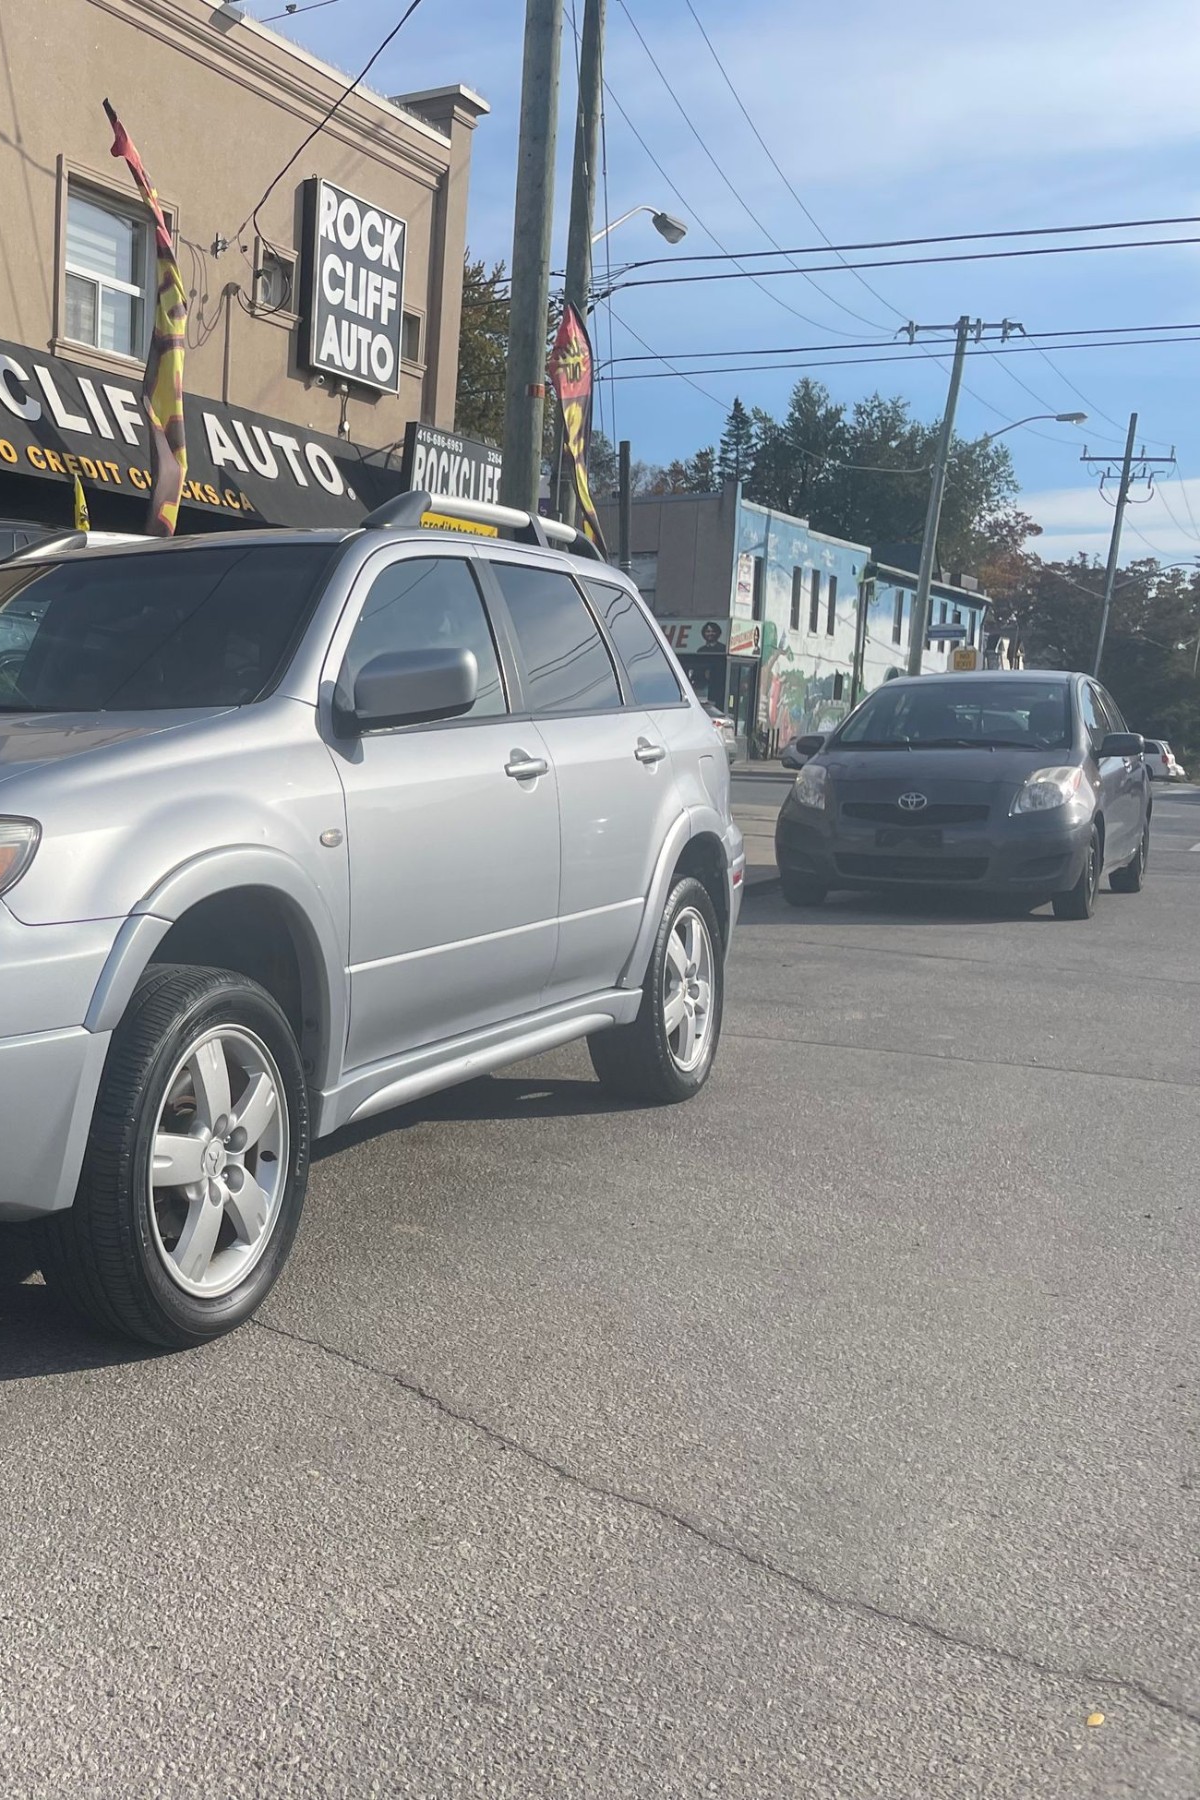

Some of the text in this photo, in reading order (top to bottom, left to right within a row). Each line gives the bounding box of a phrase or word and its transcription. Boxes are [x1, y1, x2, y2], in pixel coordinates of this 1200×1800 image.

[320, 185, 403, 272] ROCK
[322, 253, 397, 326] CLIFF
[319, 314, 394, 382] AUTO
[26, 445, 122, 484] CREDIT
